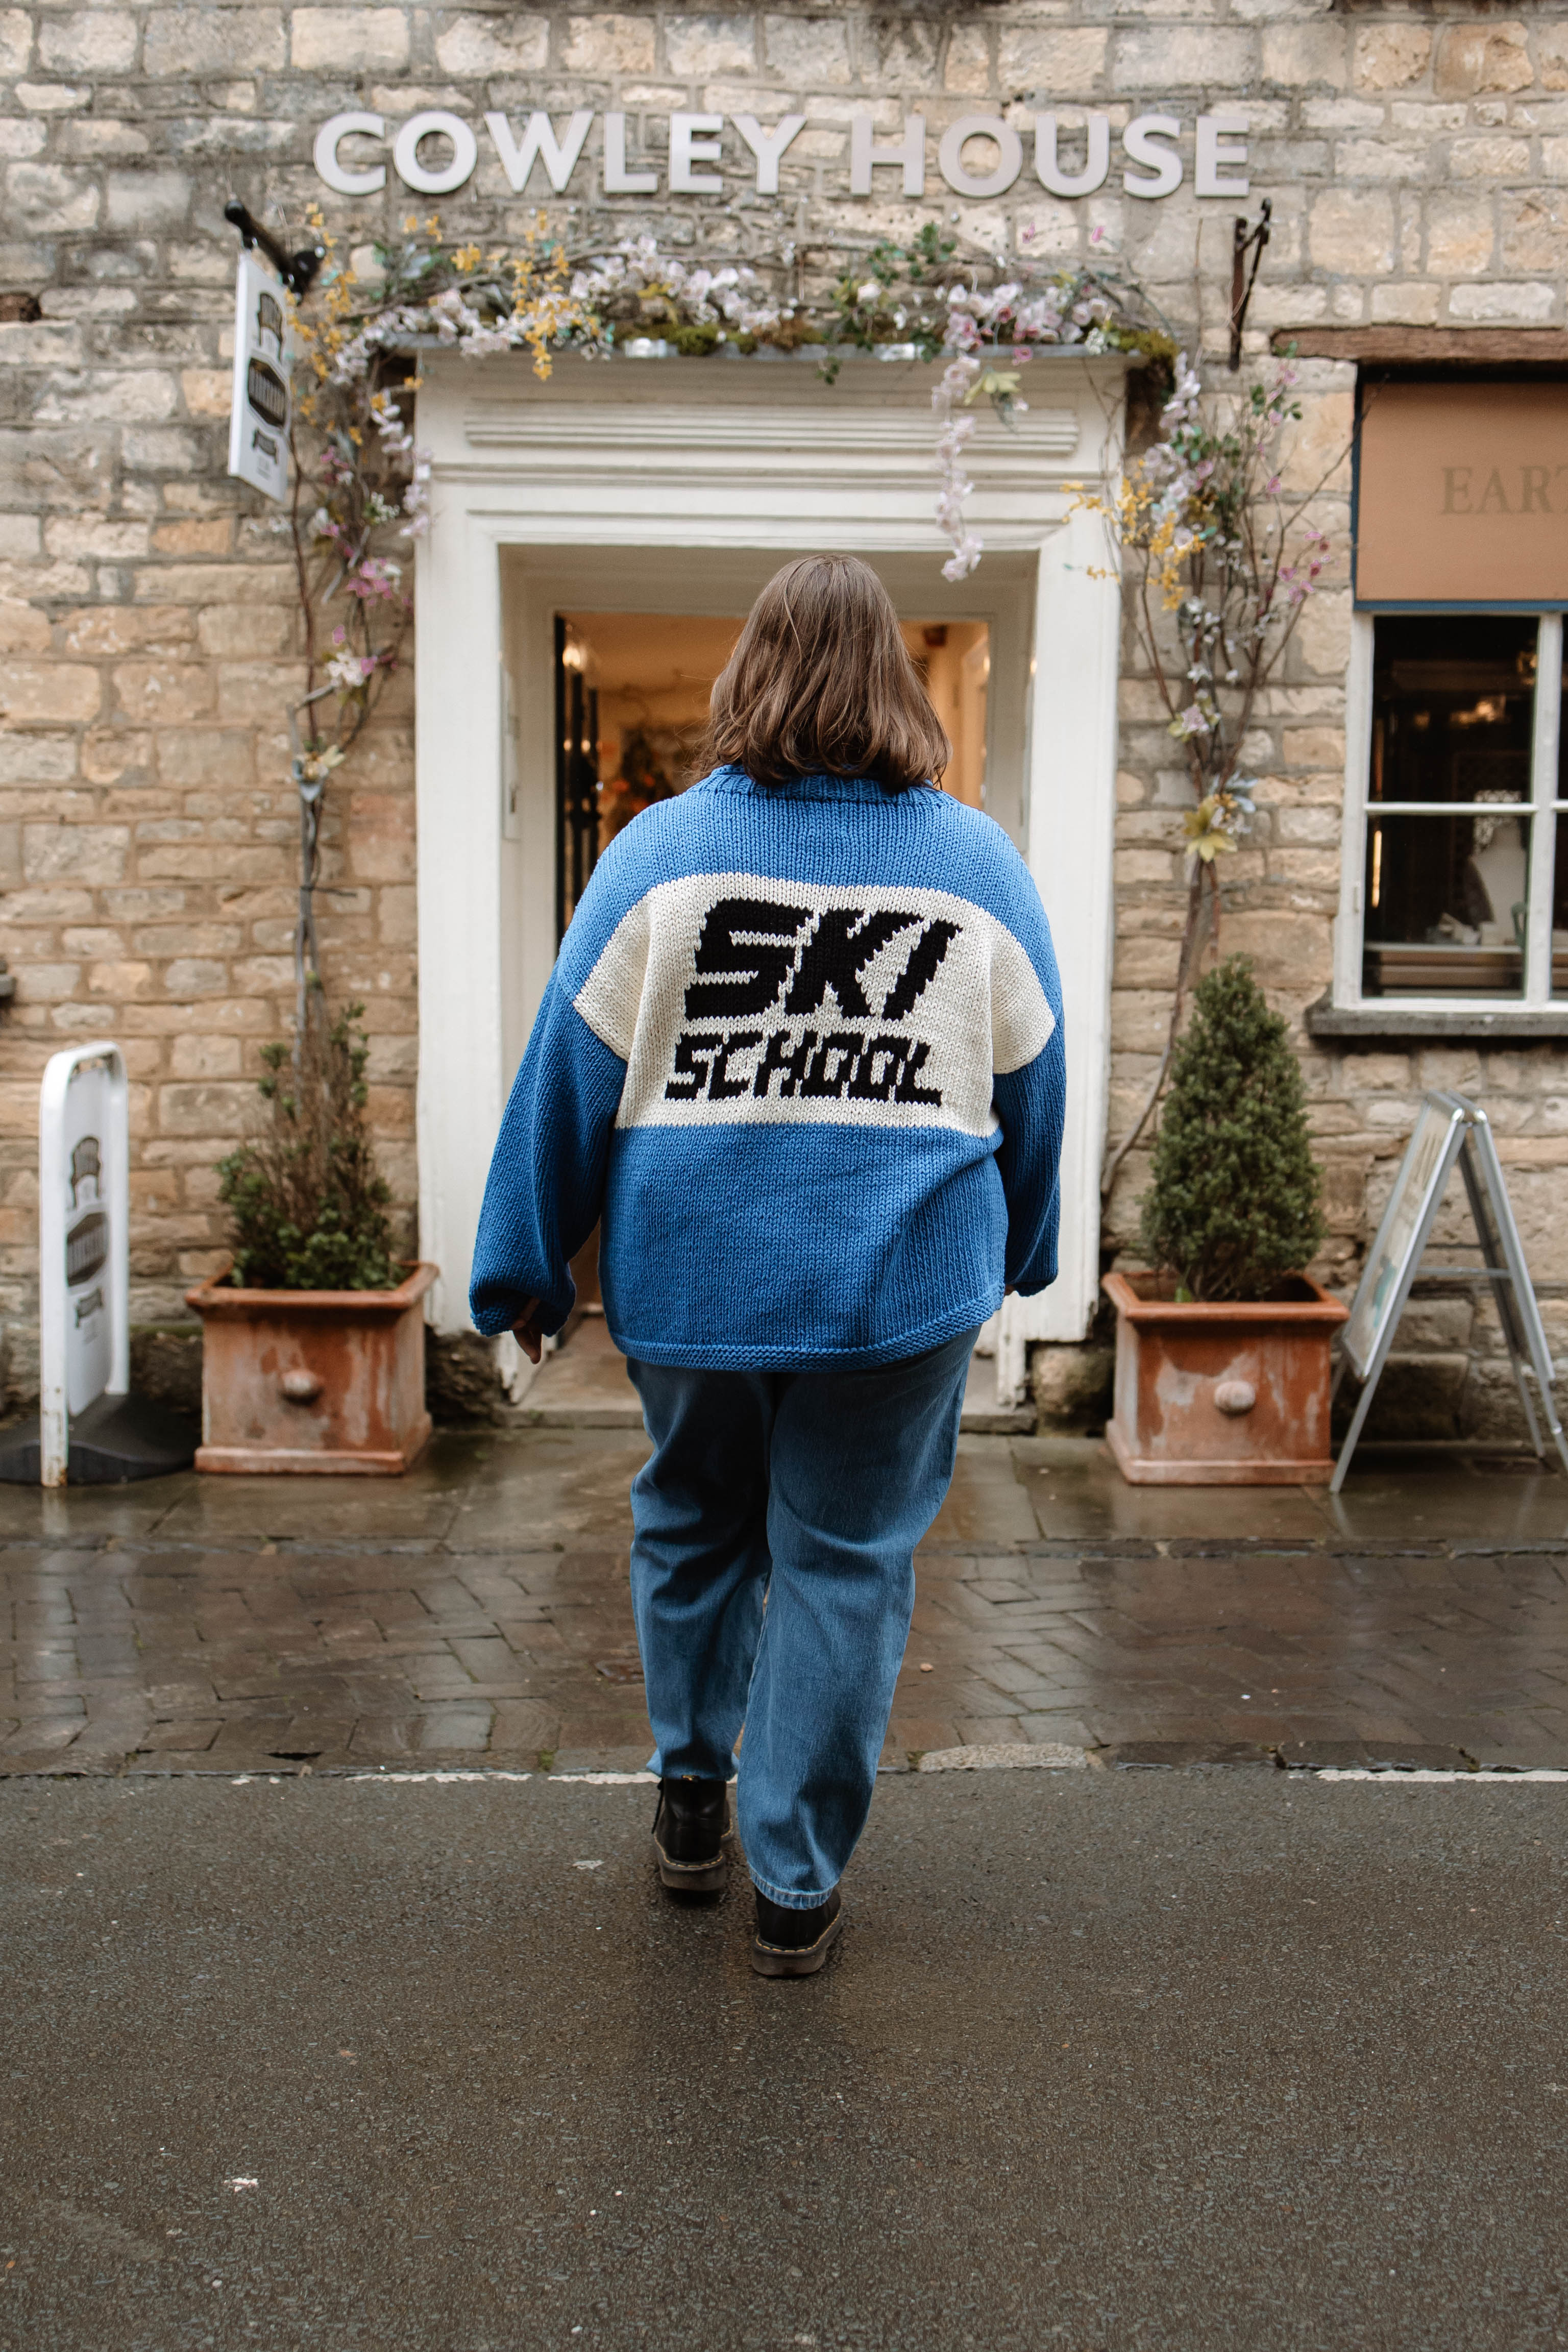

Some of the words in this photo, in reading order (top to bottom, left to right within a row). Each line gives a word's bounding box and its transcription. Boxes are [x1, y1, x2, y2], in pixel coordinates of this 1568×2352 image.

[313, 110, 807, 195] COWLEY
[850, 113, 1250, 199] HOUSE
[685, 898, 963, 1021] SKI
[664, 1030, 942, 1107] SCHOOL
